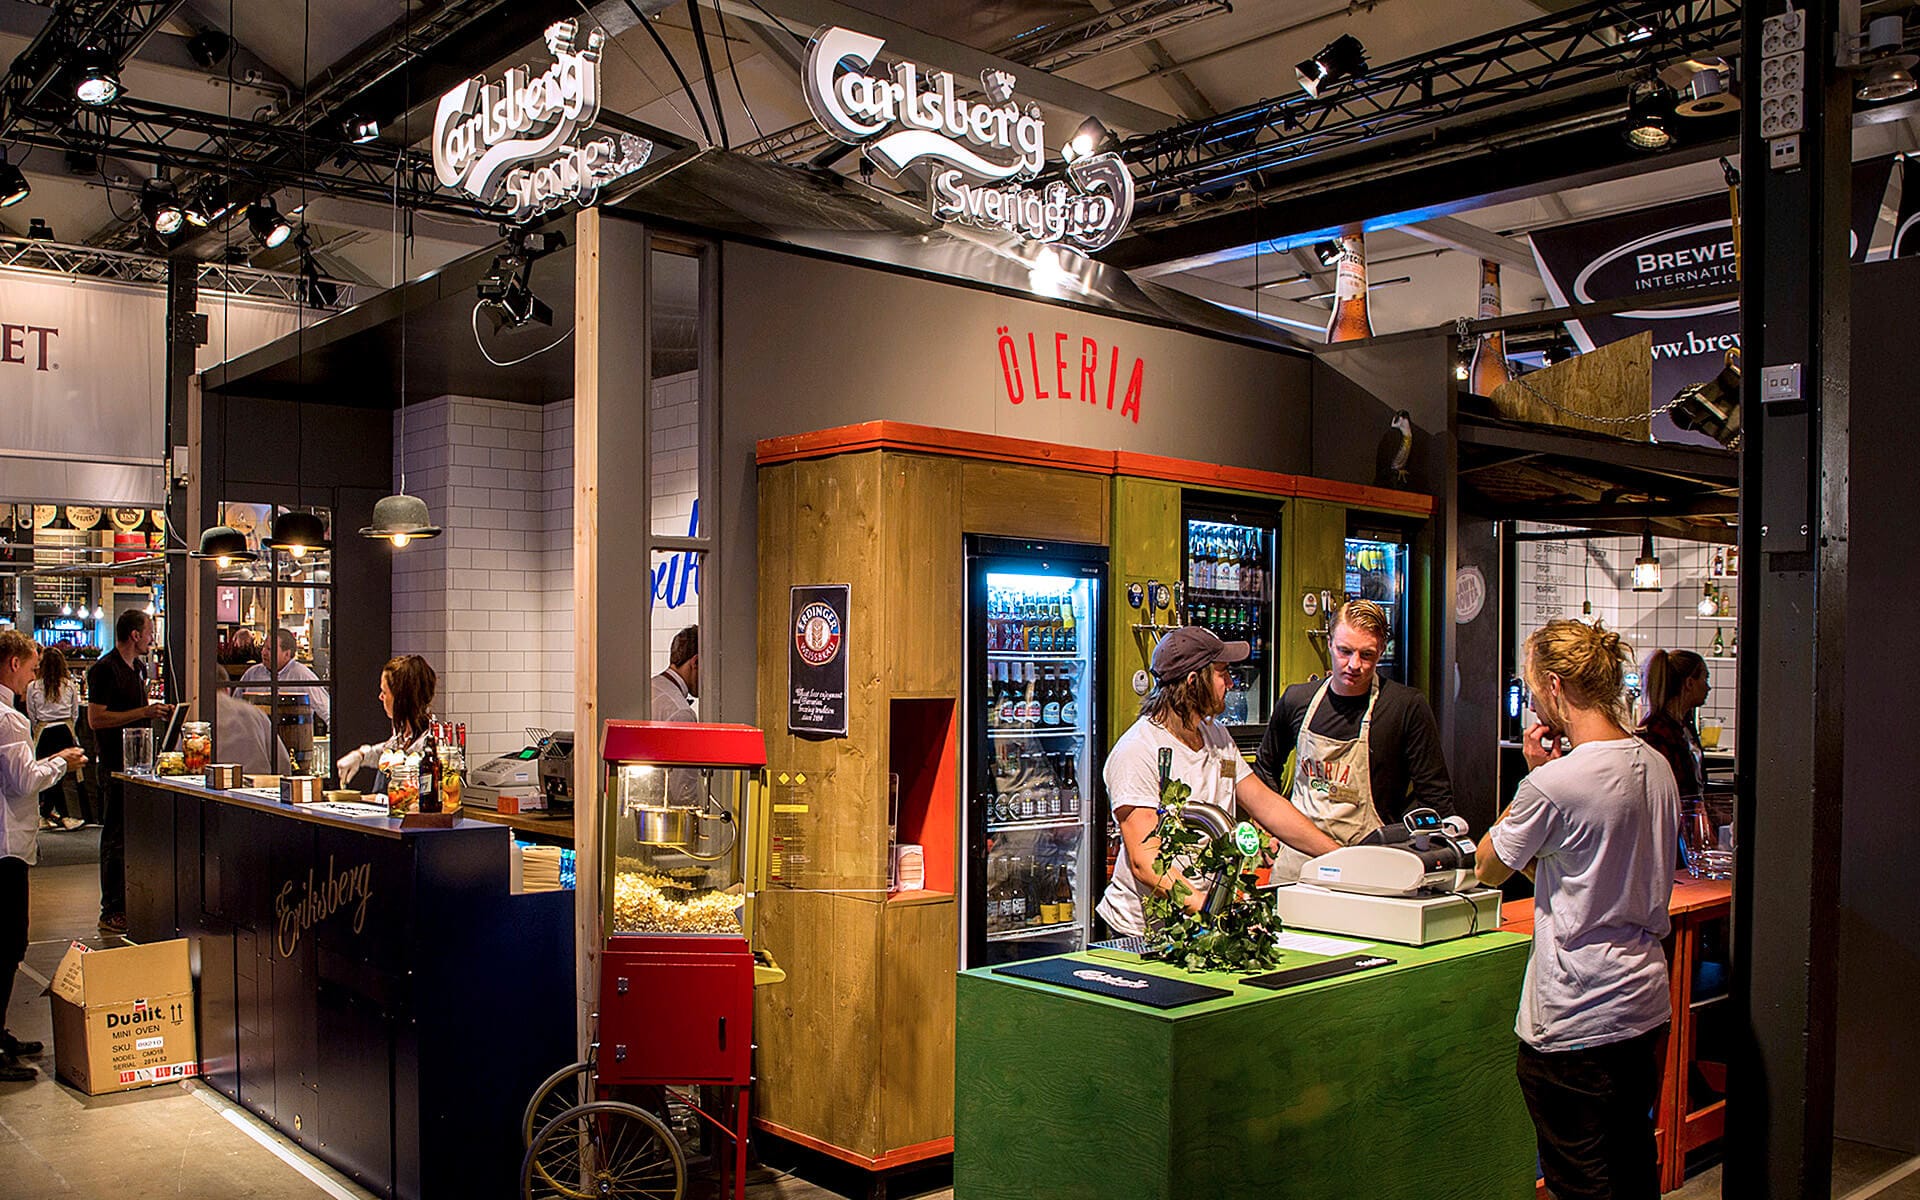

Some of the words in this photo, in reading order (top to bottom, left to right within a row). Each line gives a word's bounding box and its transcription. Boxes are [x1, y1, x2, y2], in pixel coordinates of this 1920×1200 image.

[433, 48, 598, 188] Carlsberg
[808, 26, 1045, 182] Carlsberg
[997, 326, 1144, 424] ÖLERIA
[798, 606, 837, 632] ERDINGER
[275, 854, 373, 958] Eriksberg
[107, 1007, 163, 1029] Dualit
[112, 1029, 131, 1039] MINI
[135, 1025, 160, 1036] OVEN
